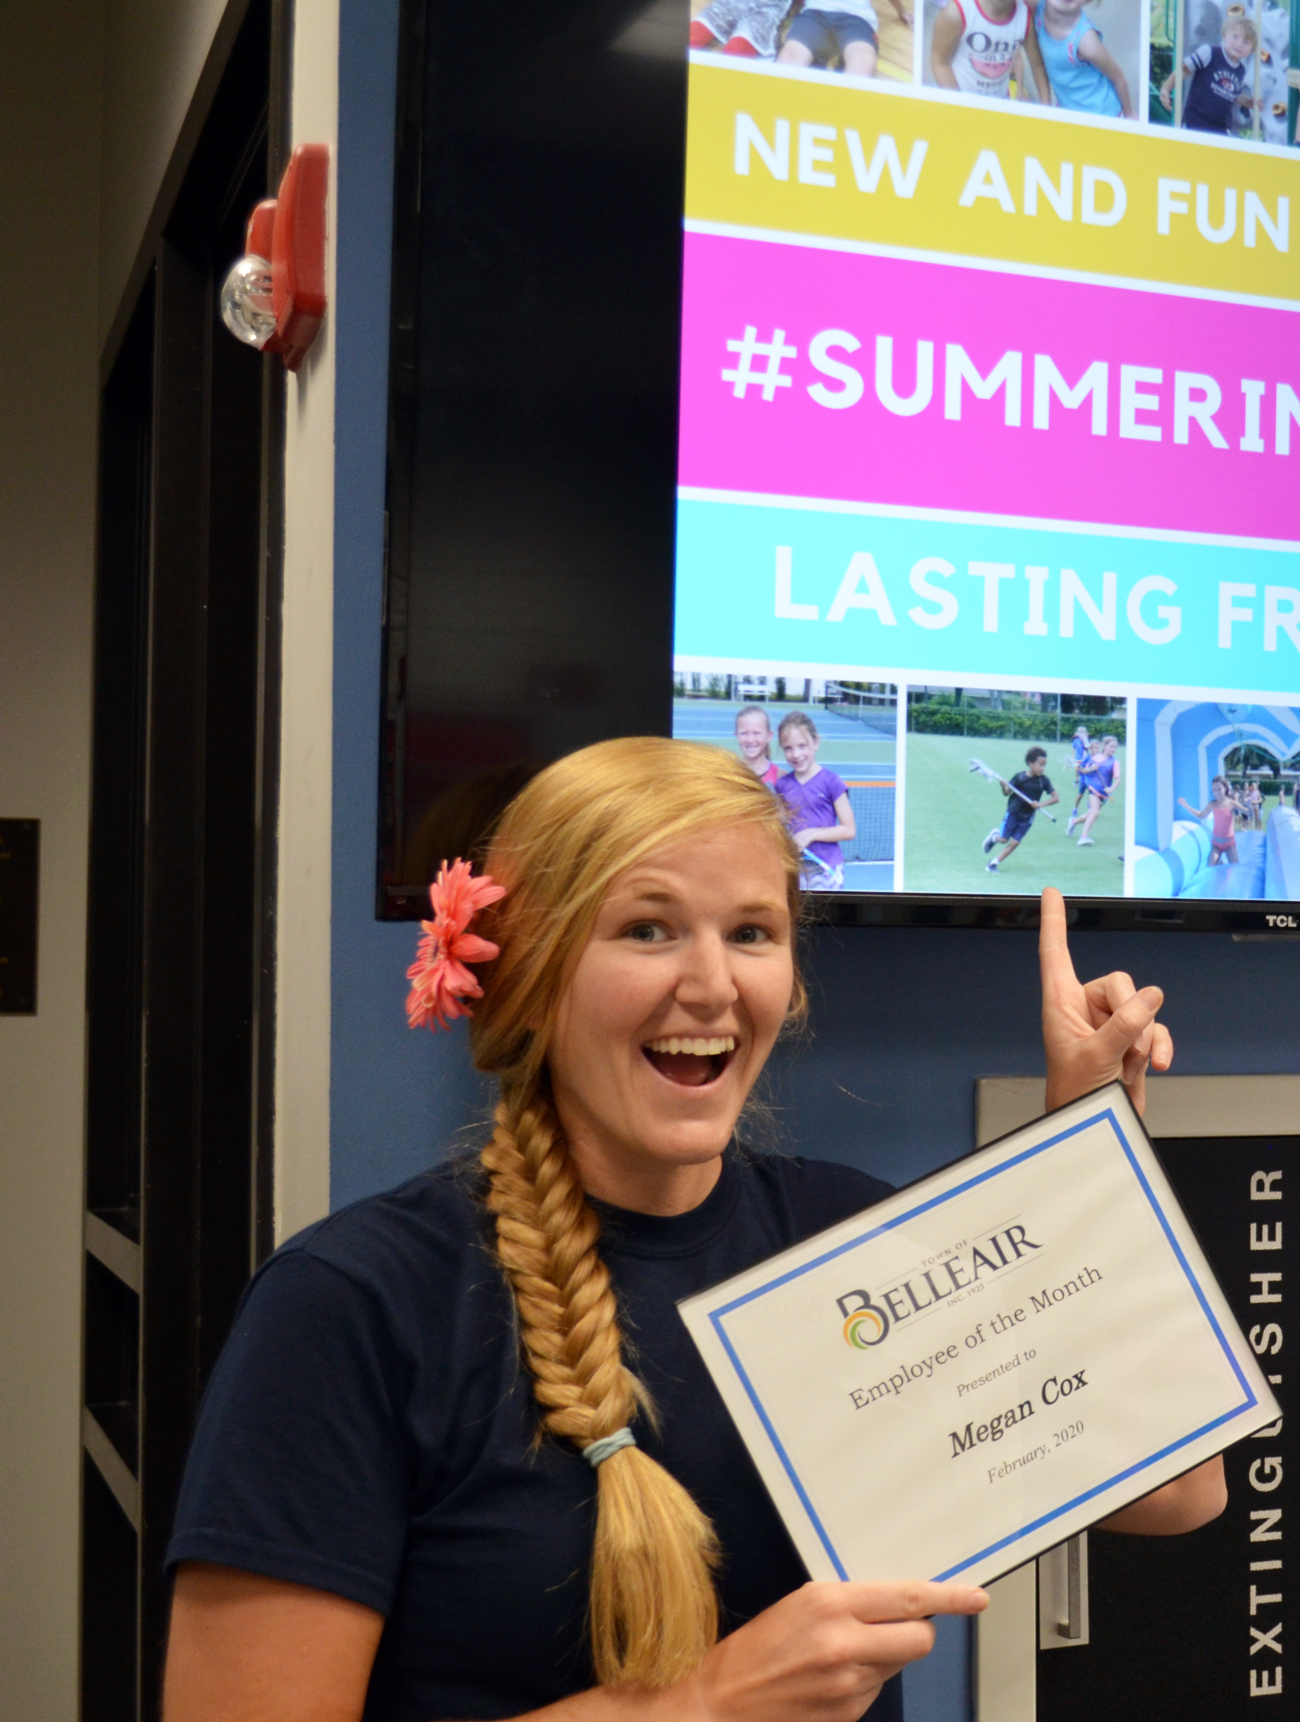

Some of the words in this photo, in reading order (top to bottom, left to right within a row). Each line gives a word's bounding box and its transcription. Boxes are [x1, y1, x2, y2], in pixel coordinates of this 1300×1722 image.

[733, 112, 929, 199] NEW
[958, 149, 1128, 227] AND
[1156, 177, 1290, 254] FUN
[774, 545, 1183, 646] LASTING
[1265, 914, 1297, 928] TCL
[835, 1224, 1044, 1350] BELLEAIR
[921, 1248, 952, 1268] TOWN
[955, 1239, 969, 1250] OF
[967, 1283, 986, 1296] 1925
[848, 1345, 959, 1411] Employee
[965, 1324, 987, 1349] of
[990, 1308, 1027, 1336] the
[1029, 1266, 1104, 1314] Month
[956, 1354, 1022, 1398] Presented
[1024, 1349, 1037, 1361] to
[948, 1399, 1035, 1459] Megan
[1041, 1368, 1089, 1406] Cox
[987, 1444, 1051, 1484] February,
[1053, 1420, 1085, 1448] 2020
[1249, 1168, 1284, 1697] EXTINGSHER
